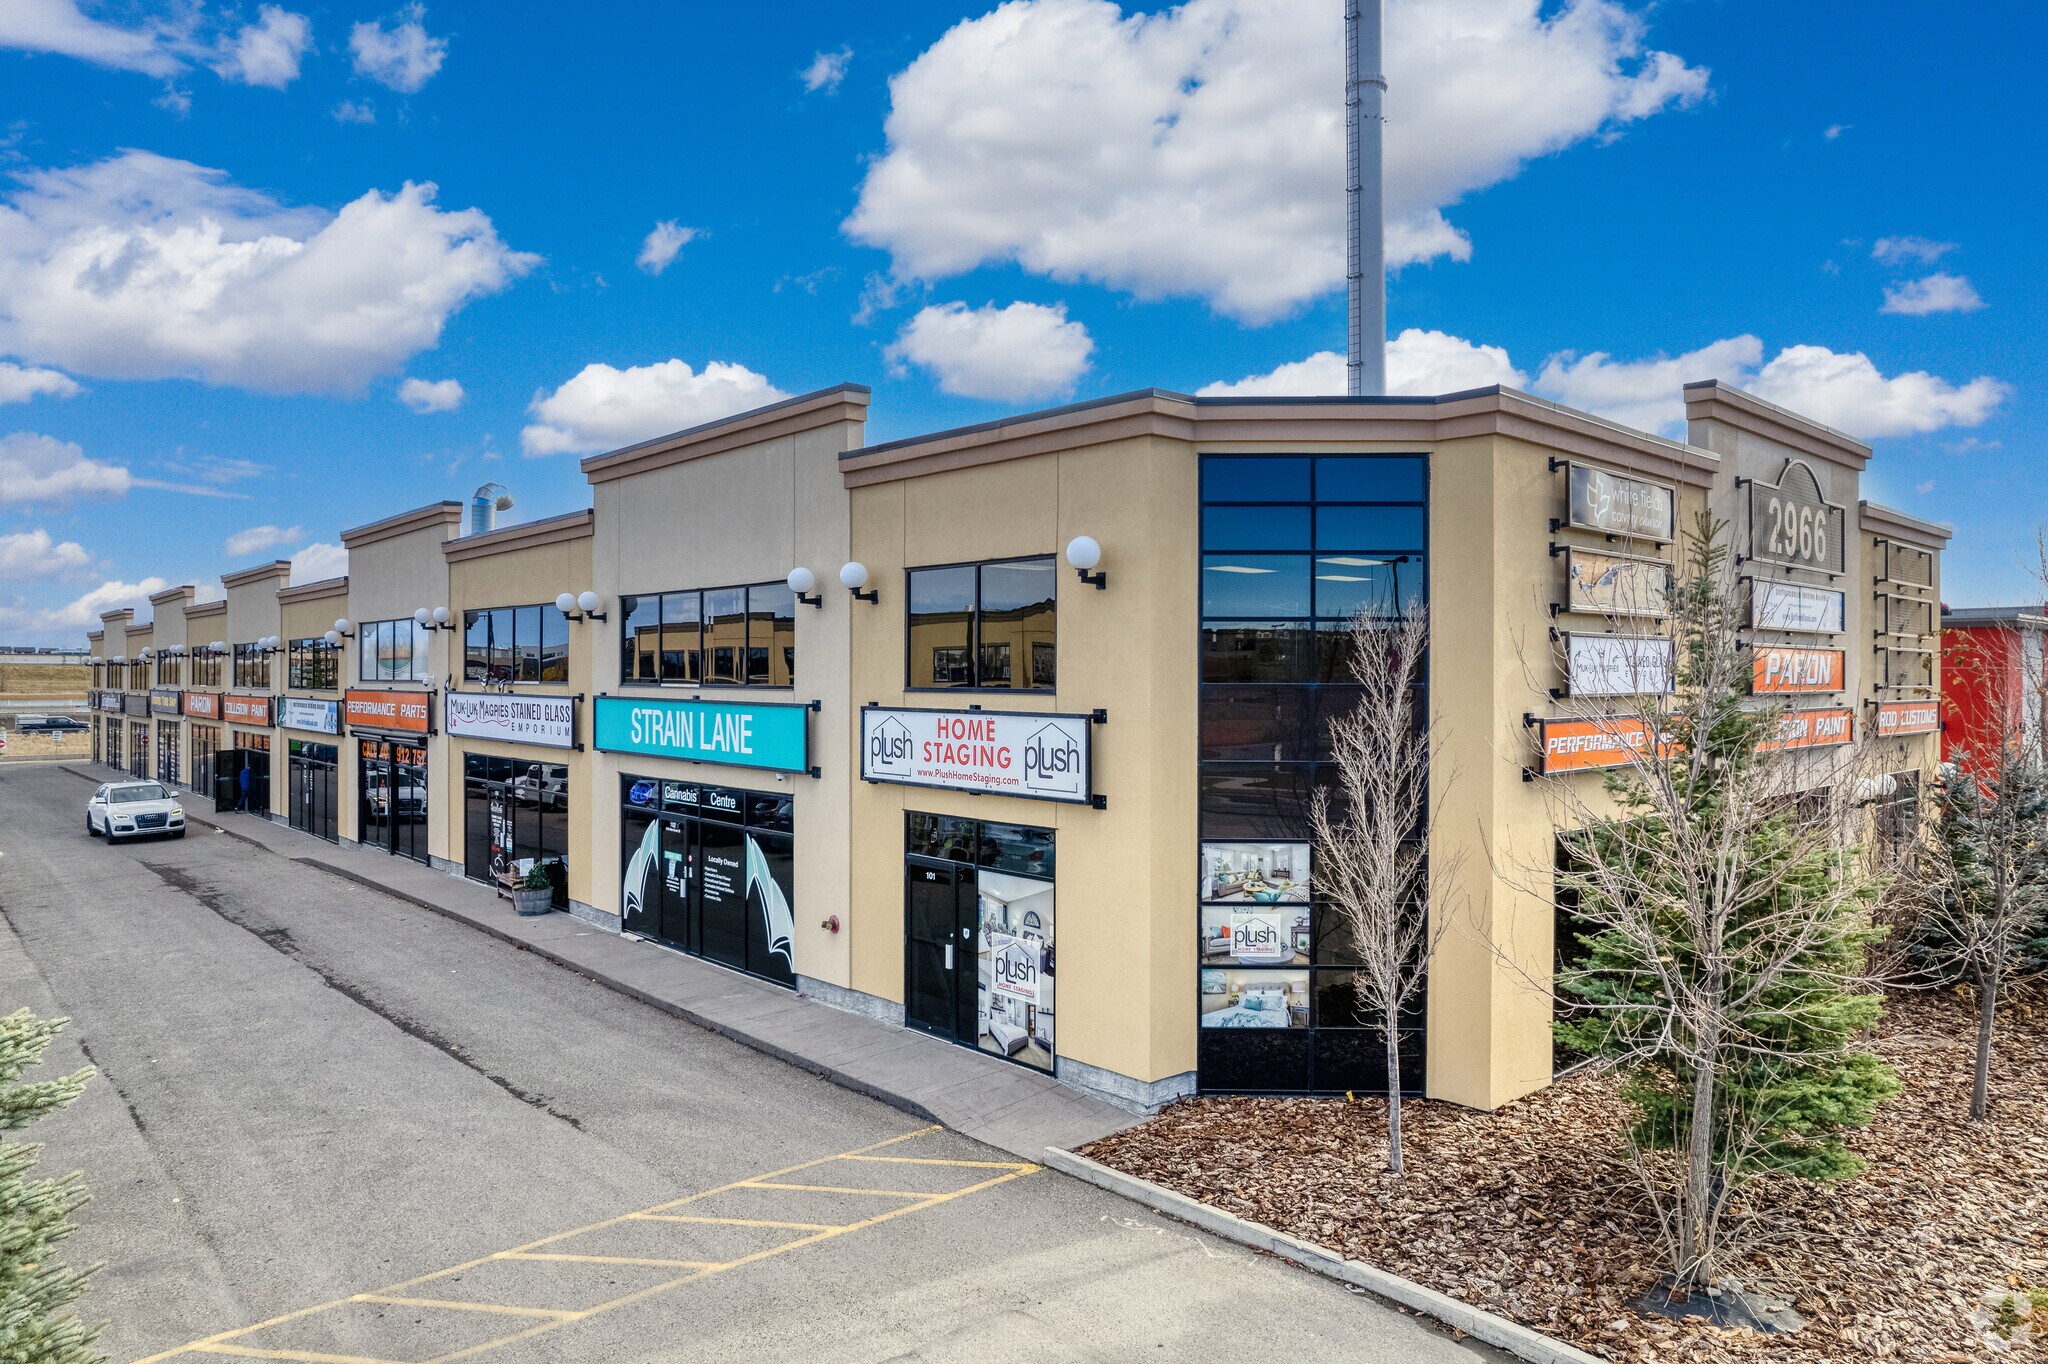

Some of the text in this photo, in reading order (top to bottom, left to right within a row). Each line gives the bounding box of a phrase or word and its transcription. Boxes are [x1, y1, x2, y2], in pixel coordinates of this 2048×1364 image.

[1641, 490, 1663, 511] fields
[1639, 509, 1663, 528] church
[1768, 497, 1826, 562] 2966
[1625, 655, 1650, 668] STNED
[1766, 652, 1832, 686] PARON
[190, 695, 212, 714] PARON
[225, 702, 267, 717] COLLISION PAINT
[347, 701, 427, 719] PERFORMANCE PARTS
[479, 700, 509, 719] MAGPIES
[511, 703, 541, 720] STAINED
[544, 705, 571, 723] GLASS
[1815, 716, 1848, 736] PAINT
[1878, 708, 1938, 728] ROD CUSTOMS
[511, 722, 570, 736] EMPORIUM
[631, 707, 753, 754] STRAIN LANE
[937, 717, 995, 742] HOME
[923, 741, 1012, 770] STAGING
[917, 768, 1020, 787] www.PlushHomeStaging.com
[664, 785, 697, 803] Cannabis
[710, 792, 736, 809] Centre
[925, 871, 936, 881] 101
